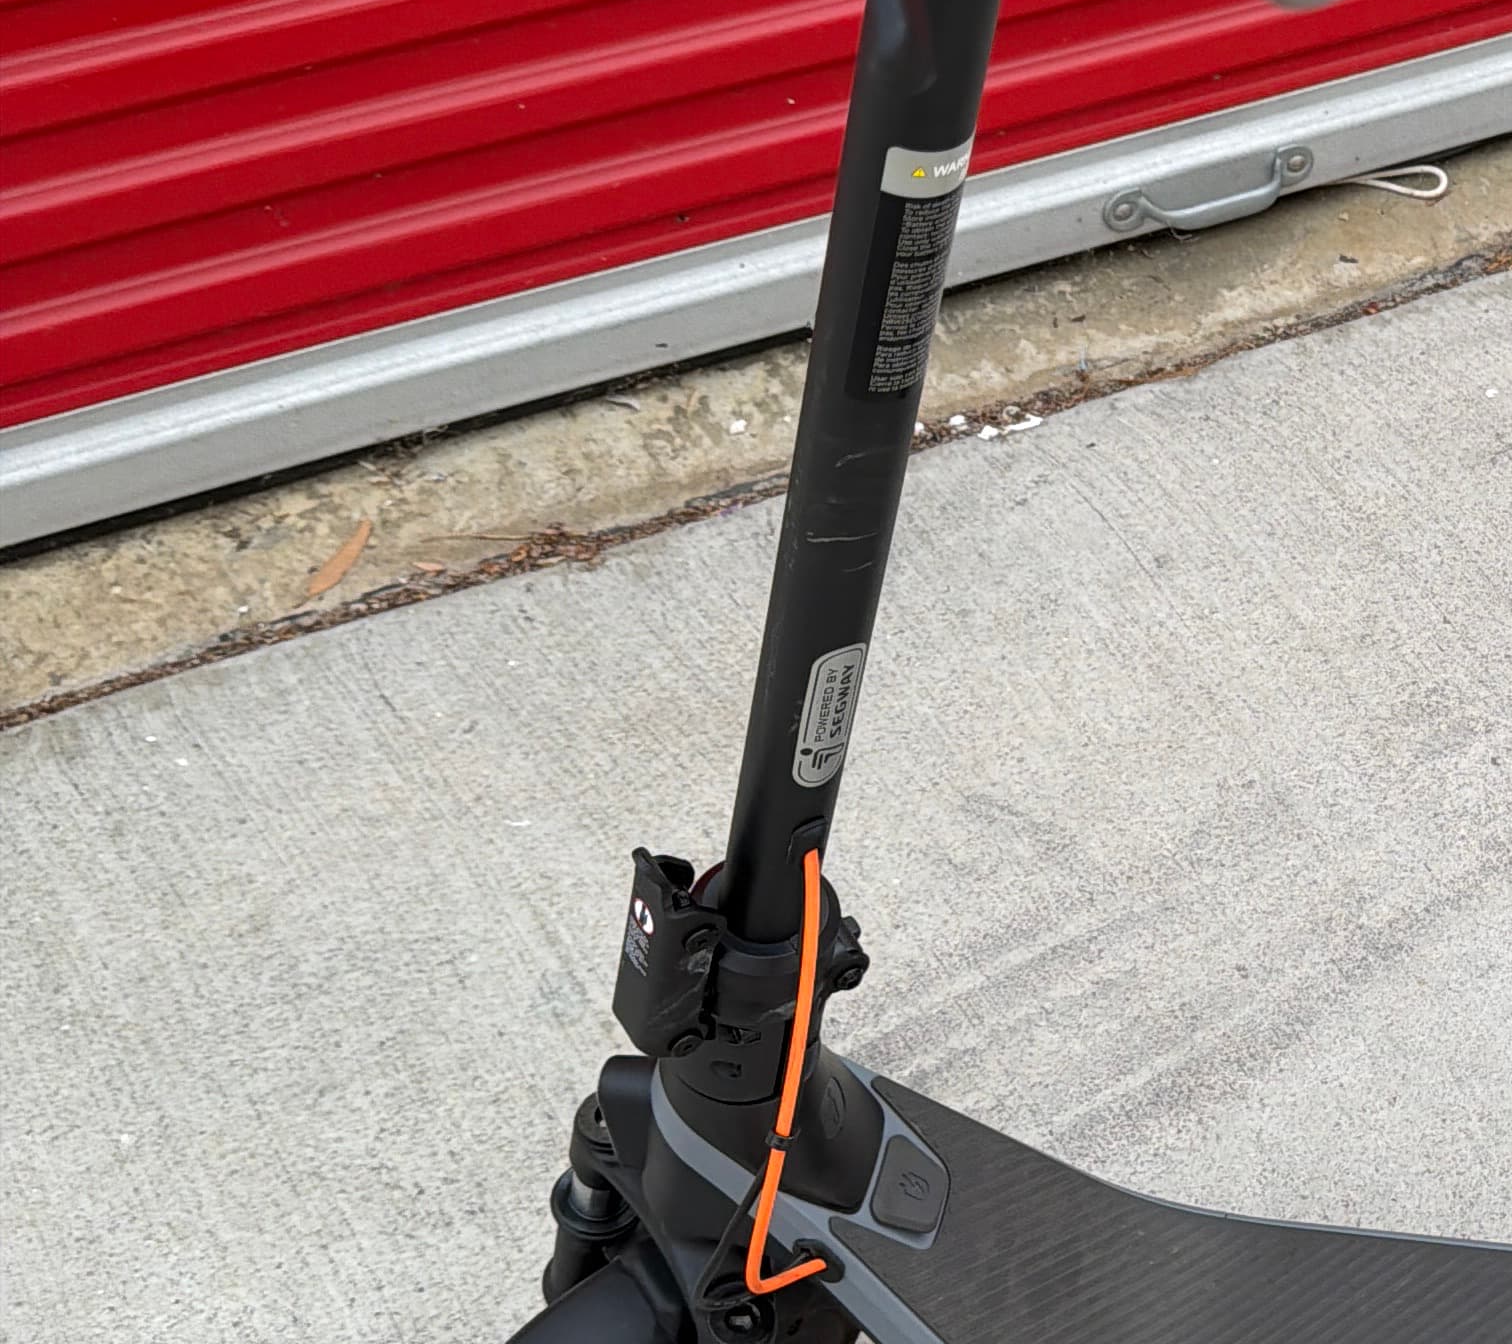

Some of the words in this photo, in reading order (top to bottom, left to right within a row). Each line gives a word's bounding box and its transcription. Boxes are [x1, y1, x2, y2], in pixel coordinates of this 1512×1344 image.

[814, 686, 834, 743] POWERED
[826, 668, 839, 684] BY
[830, 664, 856, 739] SEGWAY
